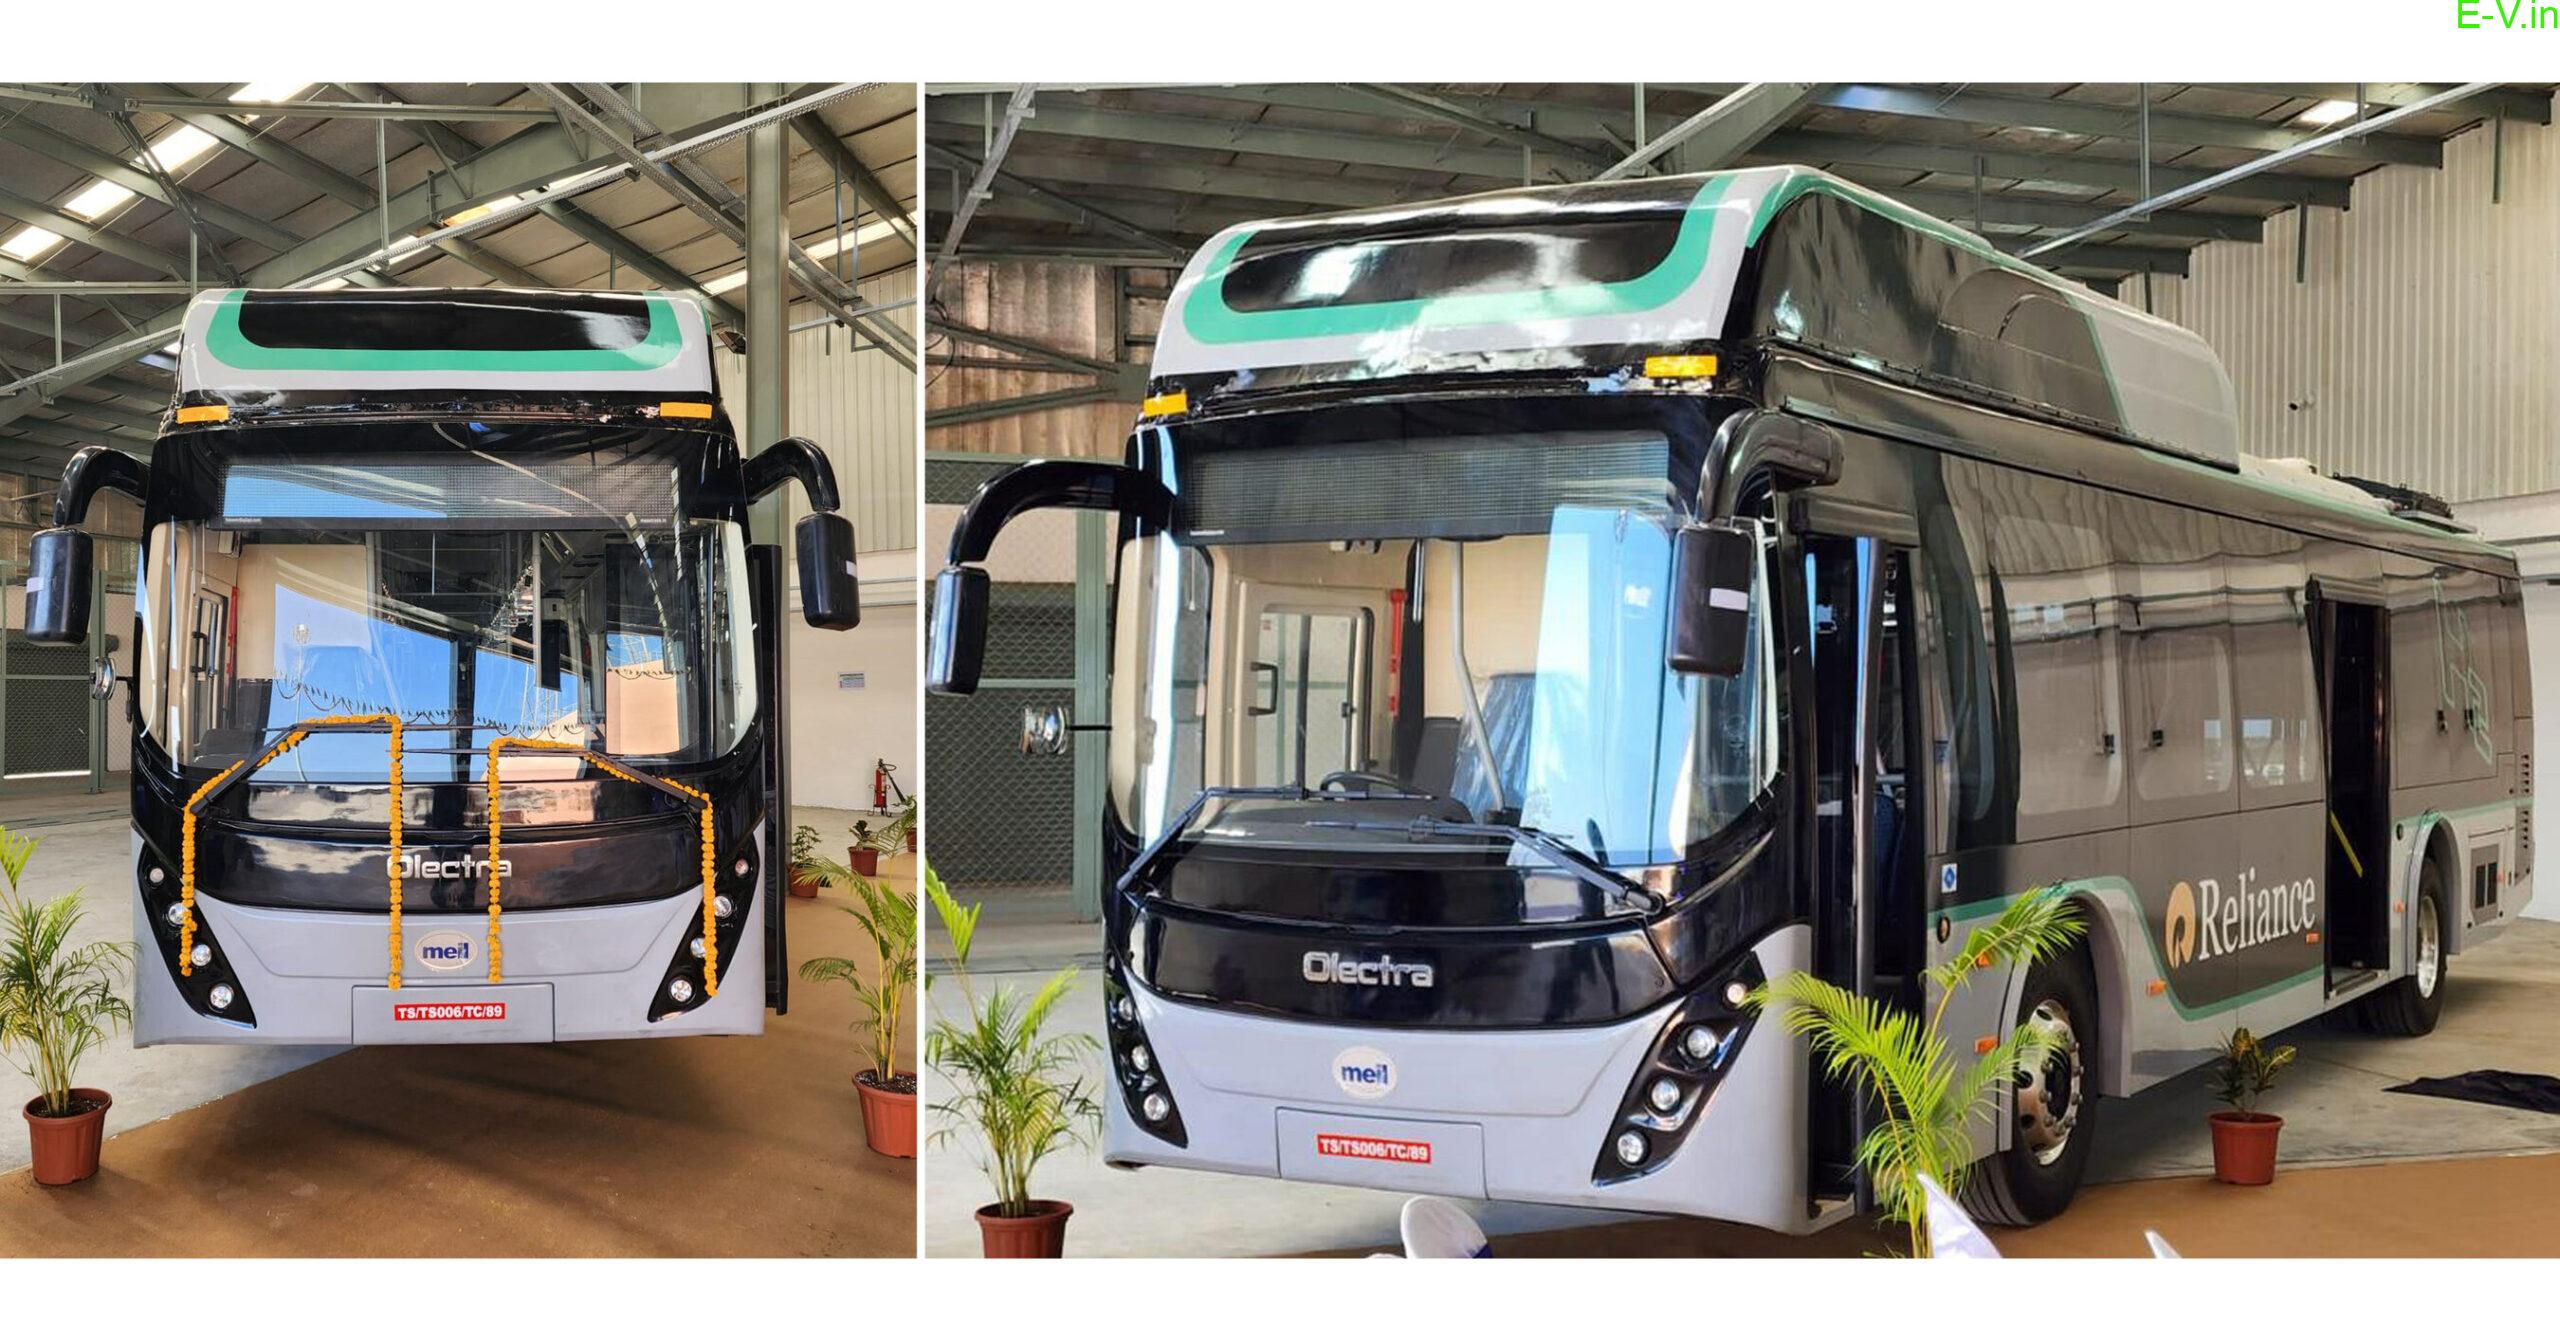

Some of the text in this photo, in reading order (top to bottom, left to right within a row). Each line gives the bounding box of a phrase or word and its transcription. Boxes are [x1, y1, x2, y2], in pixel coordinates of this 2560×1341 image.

[2198, 866, 2316, 961] Reliance
[422, 942, 469, 960] meil
[1303, 951, 1433, 987] Olectra
[398, 1005, 503, 1019] TS/TS006/TC/89
[1341, 1064, 1388, 1085] meil
[1320, 1138, 1428, 1161] TS/TS006/TC/89
